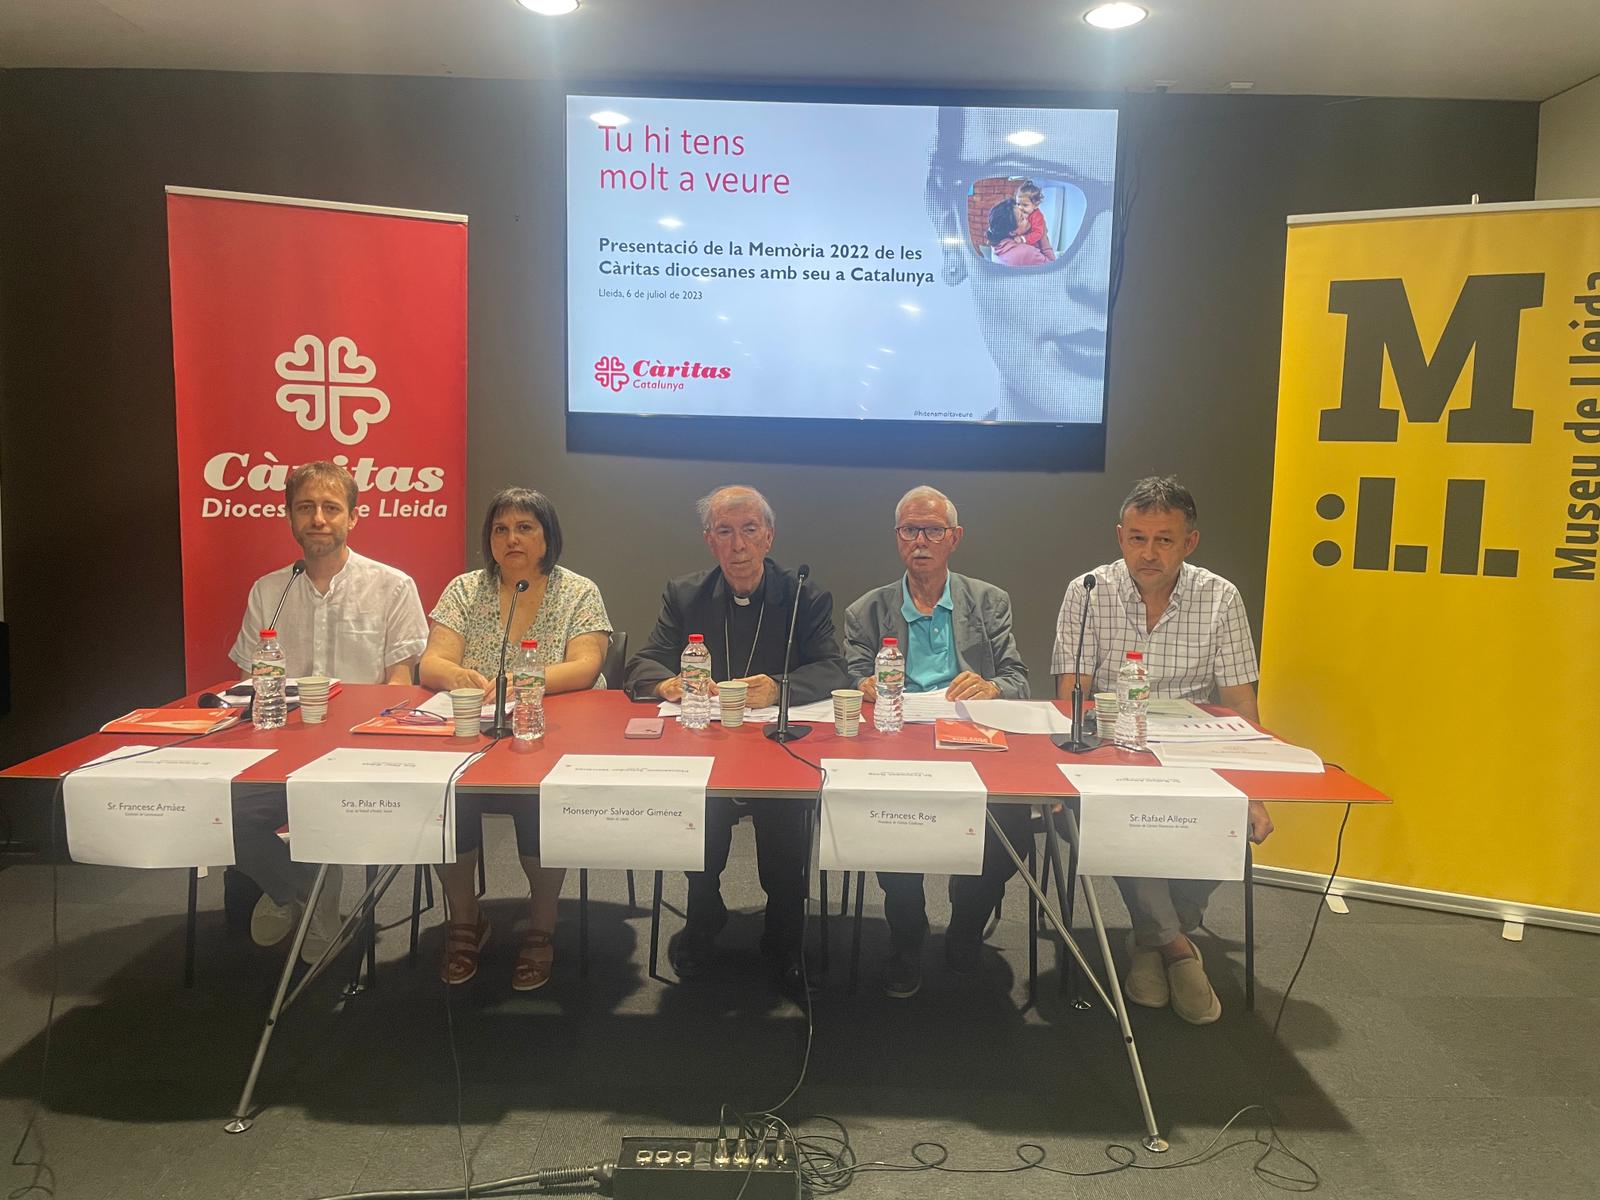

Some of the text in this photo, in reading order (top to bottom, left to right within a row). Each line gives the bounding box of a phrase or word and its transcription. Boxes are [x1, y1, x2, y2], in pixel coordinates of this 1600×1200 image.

[598, 125, 744, 156] Tu hi tens
[600, 162, 790, 194] molt a veure
[599, 237, 922, 260] Presentació de la Memòria 2022 de les
[599, 260, 934, 287] Càritas diocesanes amb seu a Catalunya
[598, 288, 703, 300] Lleida, 6 de juliol de 2023
[1318, 272, 1545, 443] M
[633, 360, 731, 379] Càritas
[633, 379, 684, 392] Catalunya
[1563, 398, 1600, 444] de
[379, 498, 447, 518] Lleida
[1552, 455, 1600, 582] Museu
[119, 802, 155, 812] Francesc
[341, 799, 401, 808] Sra. Pilar Ribas
[562, 806, 682, 817] Monsenyor Salvador Giménez
[870, 811, 880, 819] Sr.
[881, 811, 916, 821] Francesc
[918, 812, 937, 823] Roig
[1129, 814, 1197, 825] Sr. Rafael Allepuz
